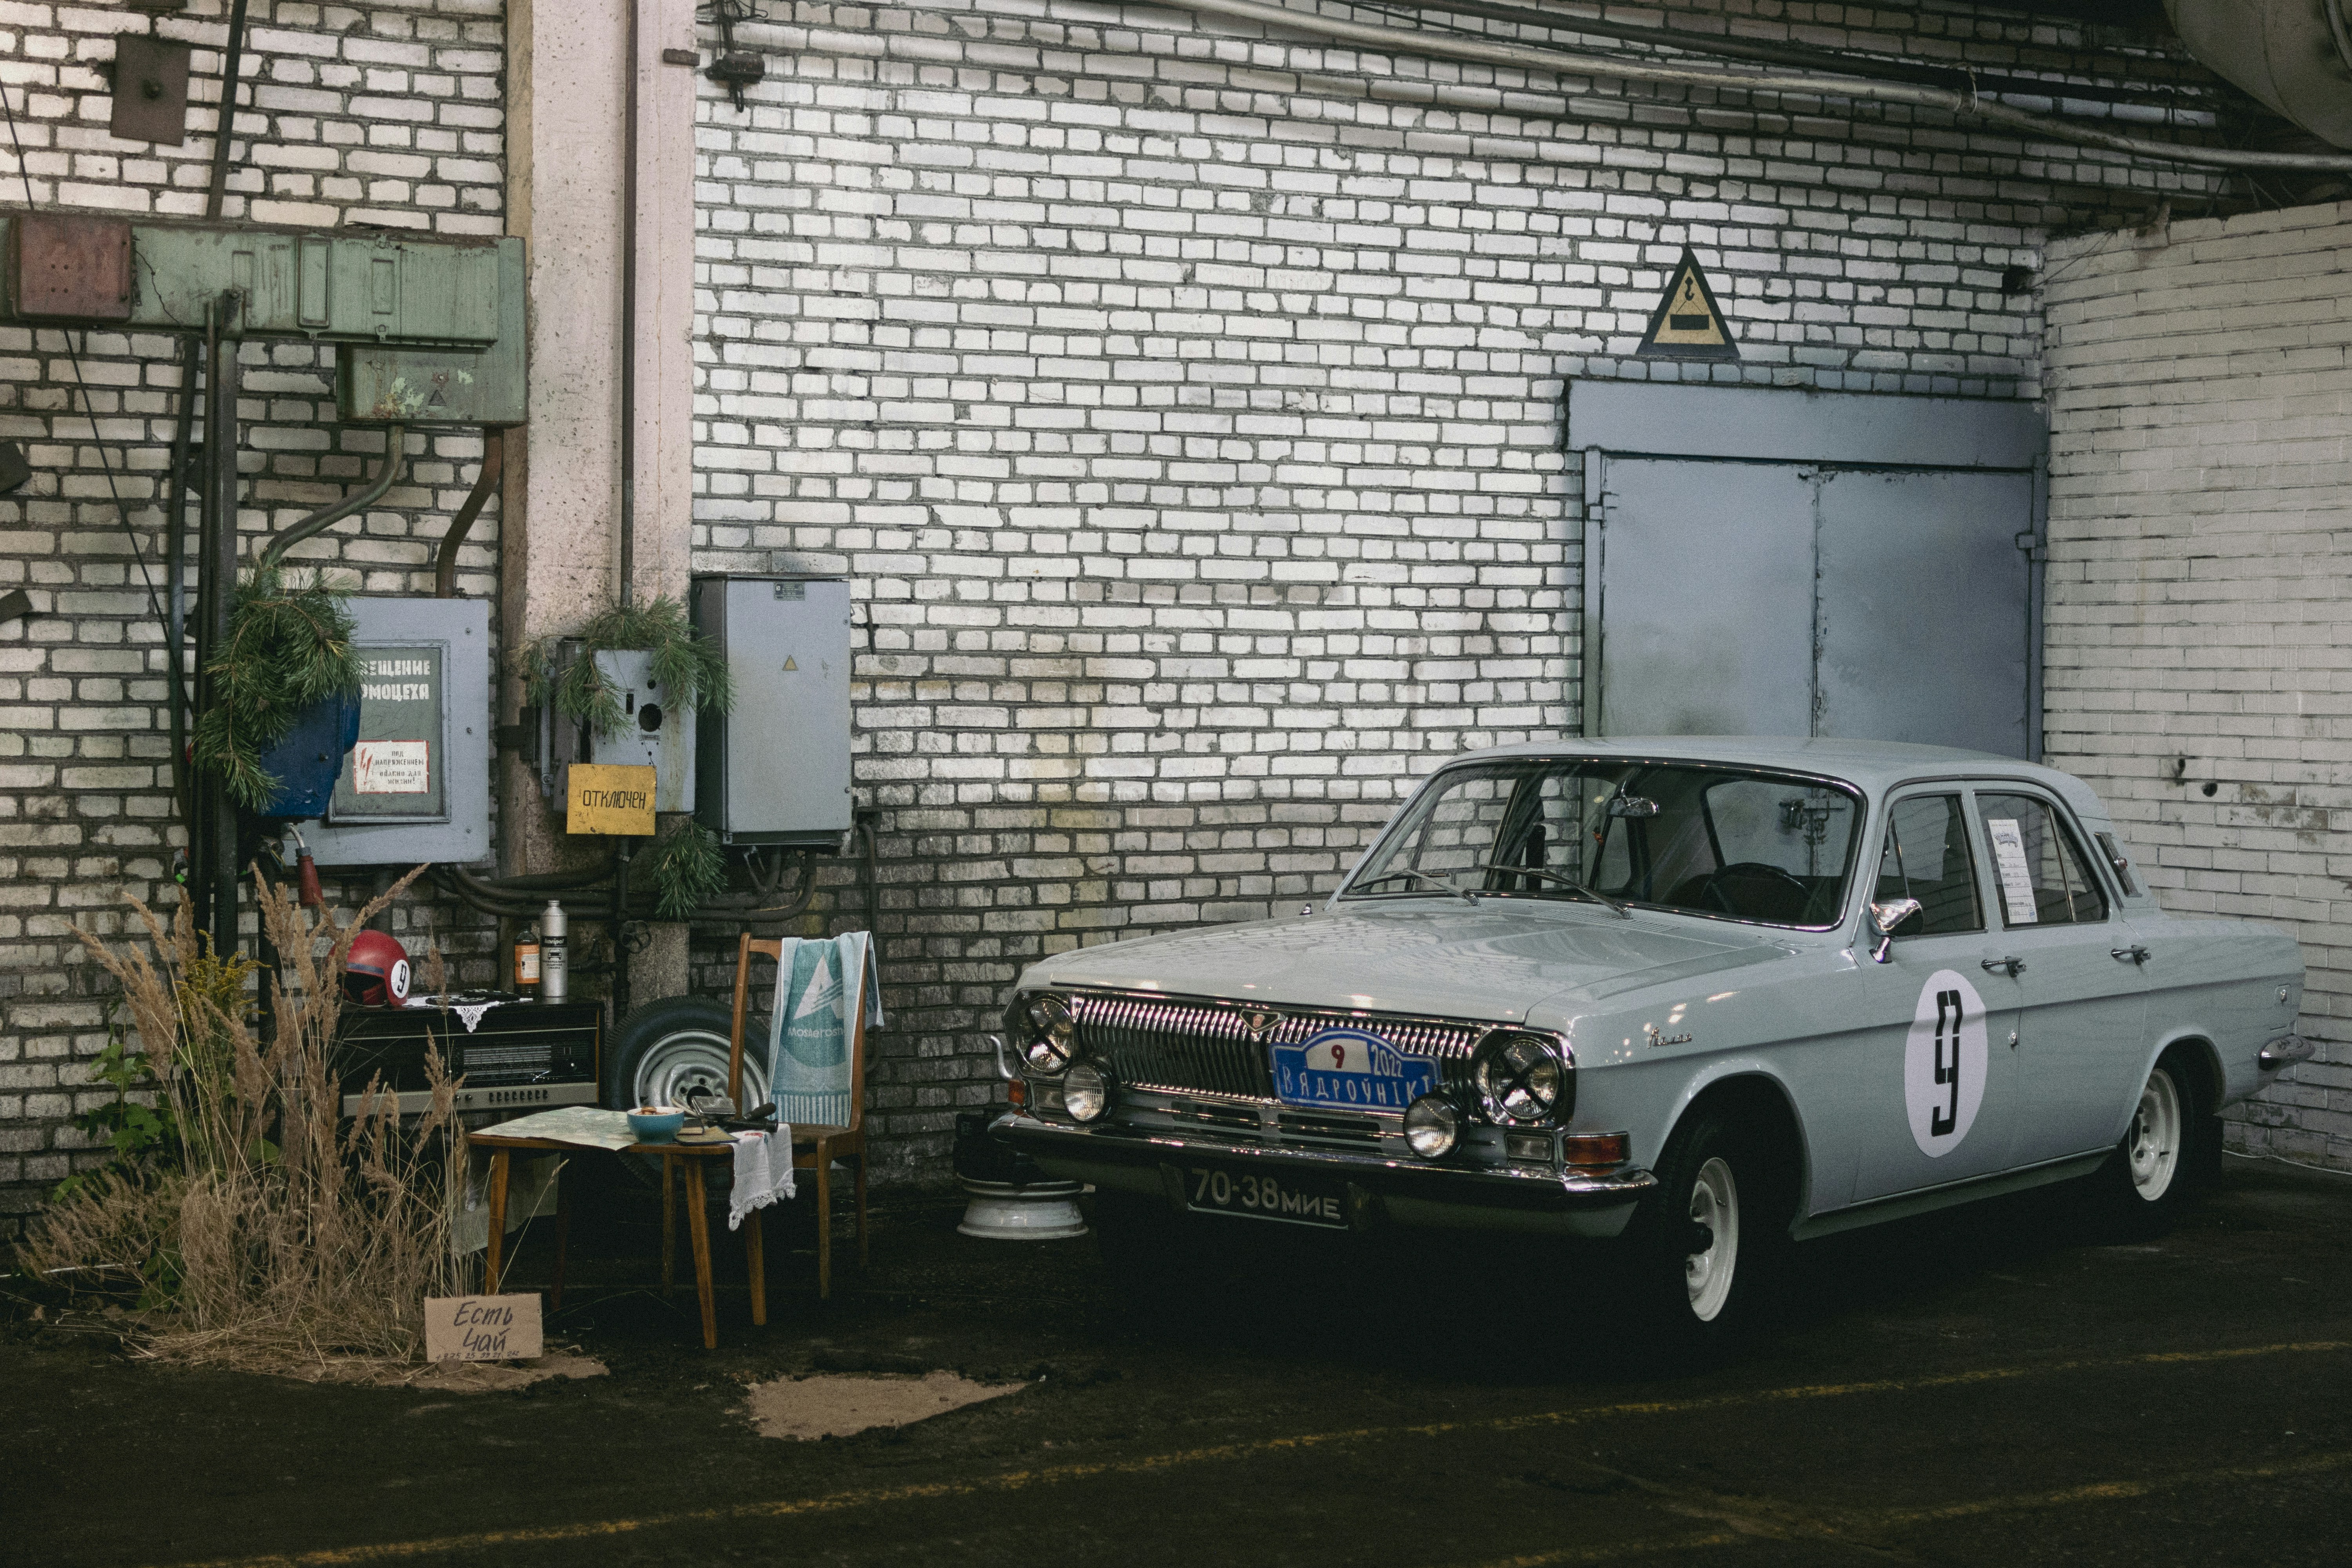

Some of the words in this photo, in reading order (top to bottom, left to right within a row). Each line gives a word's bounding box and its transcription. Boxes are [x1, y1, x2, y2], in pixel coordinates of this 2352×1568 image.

[583, 790, 646, 809] ОТКЛЮЧЕН
[397, 964, 407, 993] 9
[1331, 1045, 1345, 1069] 9
[1371, 1044, 1403, 1078] 2022
[1931, 989, 1963, 1137] 9
[453, 1301, 513, 1326] Есть
[463, 1328, 511, 1352] Чай
